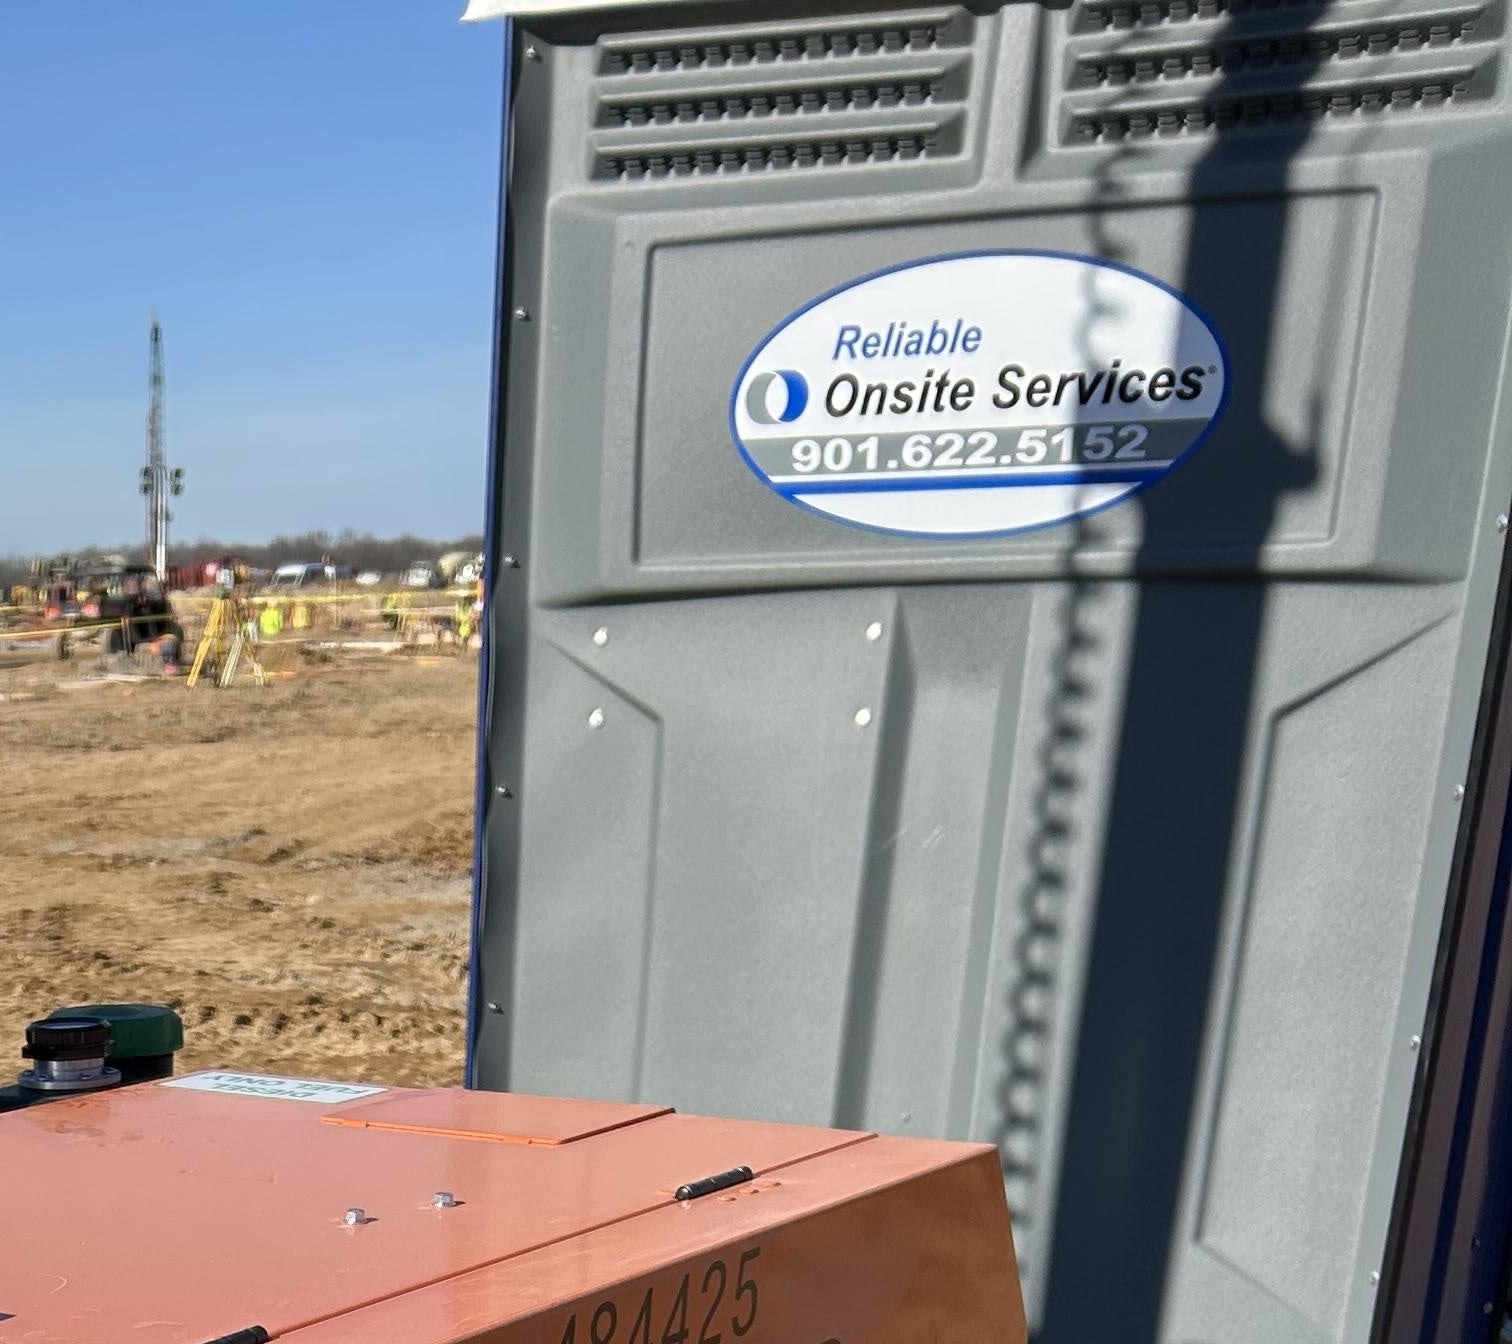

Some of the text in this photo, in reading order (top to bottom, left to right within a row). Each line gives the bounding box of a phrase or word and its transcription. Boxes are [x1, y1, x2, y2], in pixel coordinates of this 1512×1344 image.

[831, 317, 983, 361] Reliable
[824, 359, 1205, 418] Onsite Services
[791, 424, 1150, 473] 901.622.5152
[204, 1073, 369, 1095] FUEL ONLY
[212, 1082, 317, 1098] DIESEL
